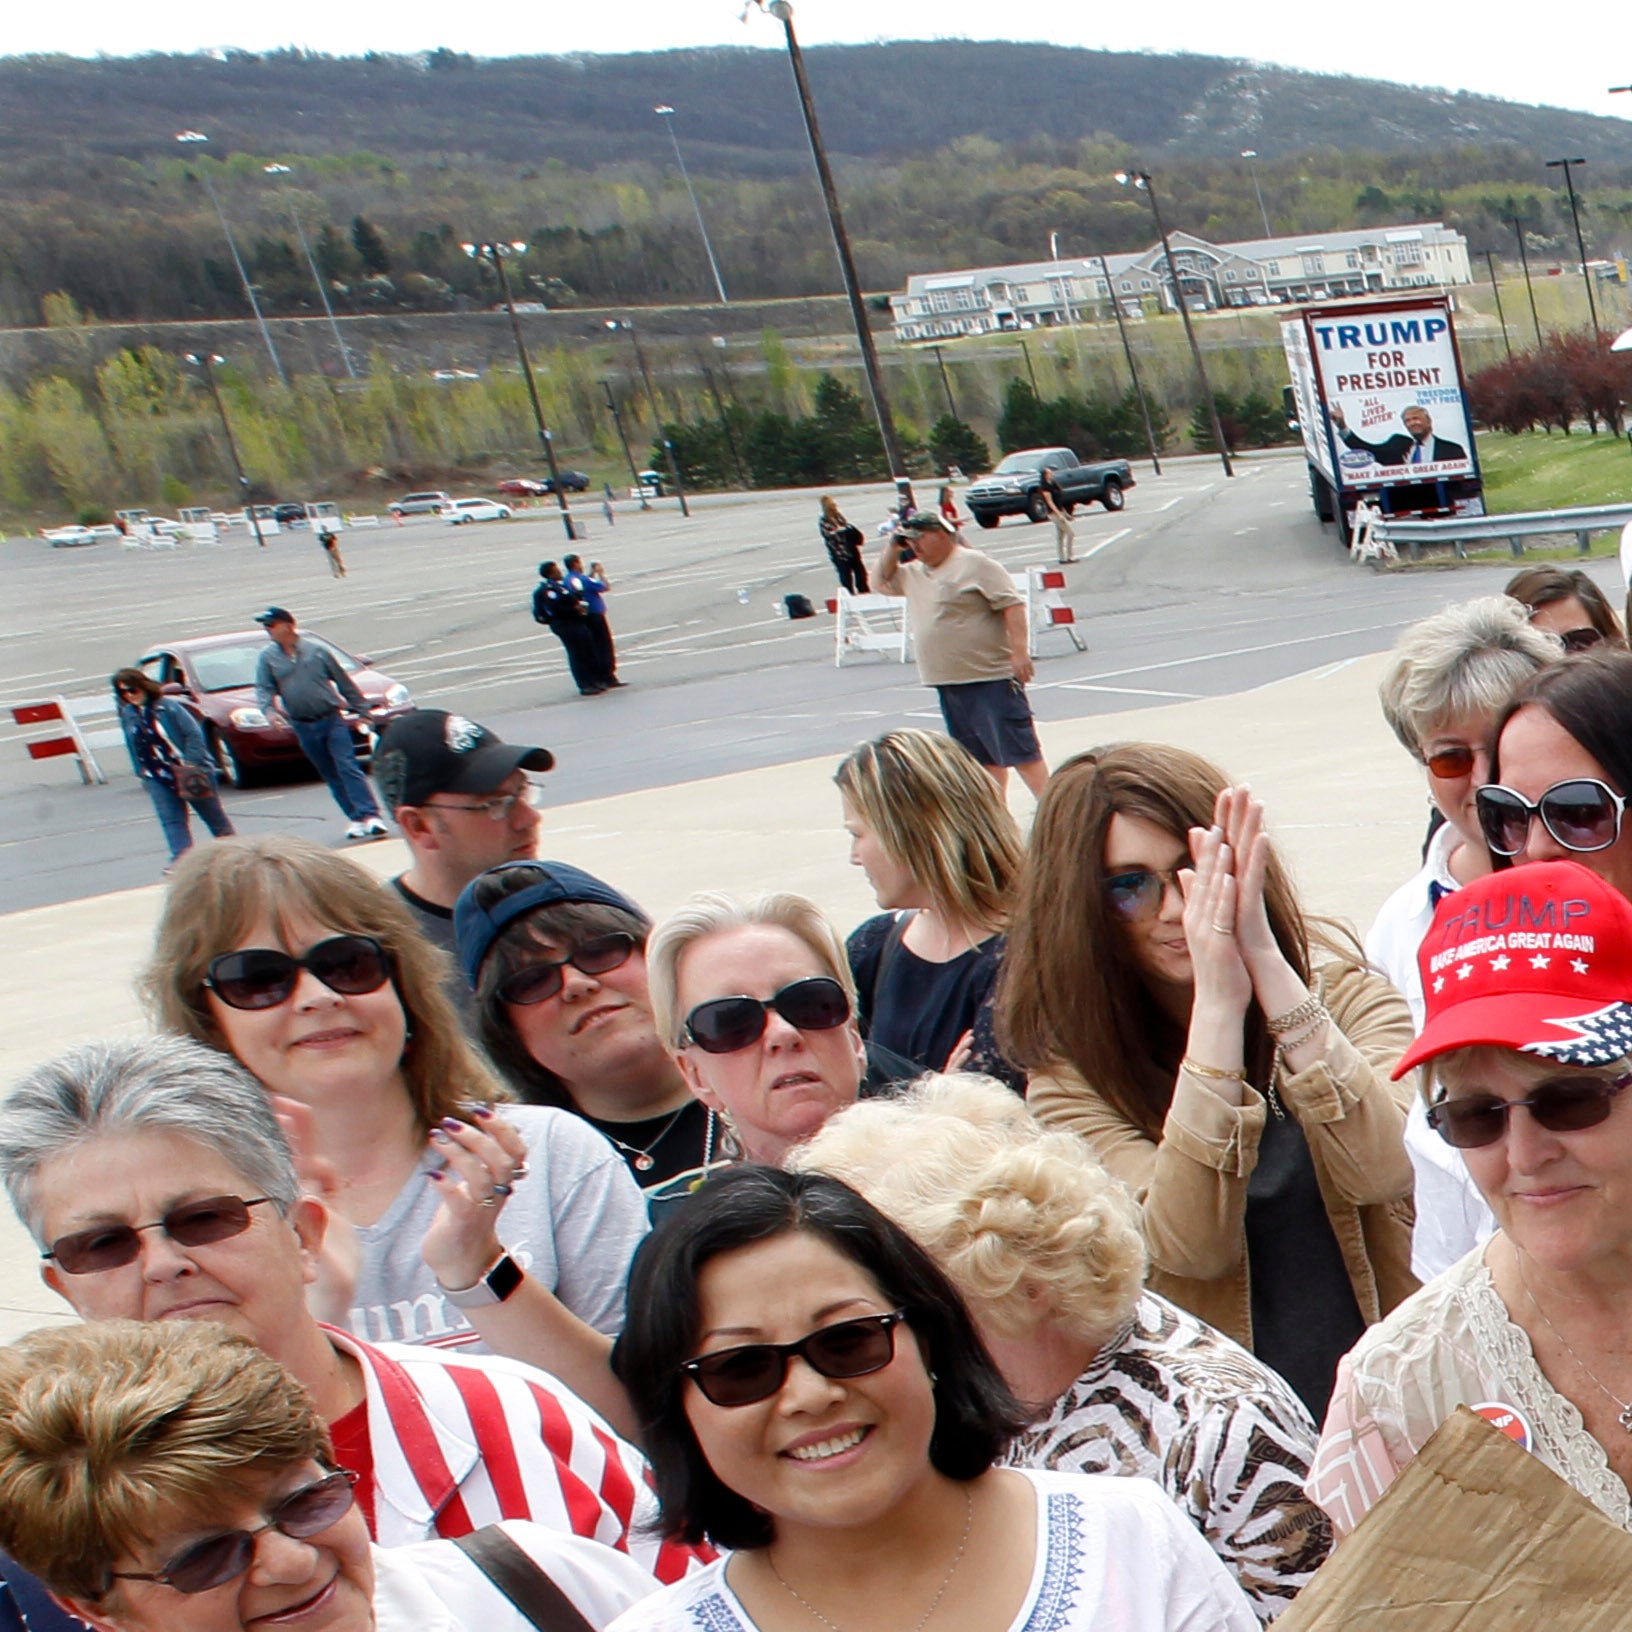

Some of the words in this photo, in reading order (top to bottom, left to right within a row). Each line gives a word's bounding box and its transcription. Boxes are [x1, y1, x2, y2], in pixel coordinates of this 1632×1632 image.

[1315, 318, 1447, 350] TRUMP
[1367, 351, 1405, 369] FOR
[1336, 367, 1442, 392] PRESIDENT
[1362, 405, 1386, 418] LIVES
[1374, 468, 1410, 479] AMERICA
[1412, 464, 1438, 474] GREAT
[1442, 895, 1591, 944] TRUMP
[1430, 947, 1456, 974] MAKE
[1455, 934, 1506, 962] AMERICA
[1507, 932, 1552, 949] GREAT
[1553, 933, 1595, 953] AGAIN
